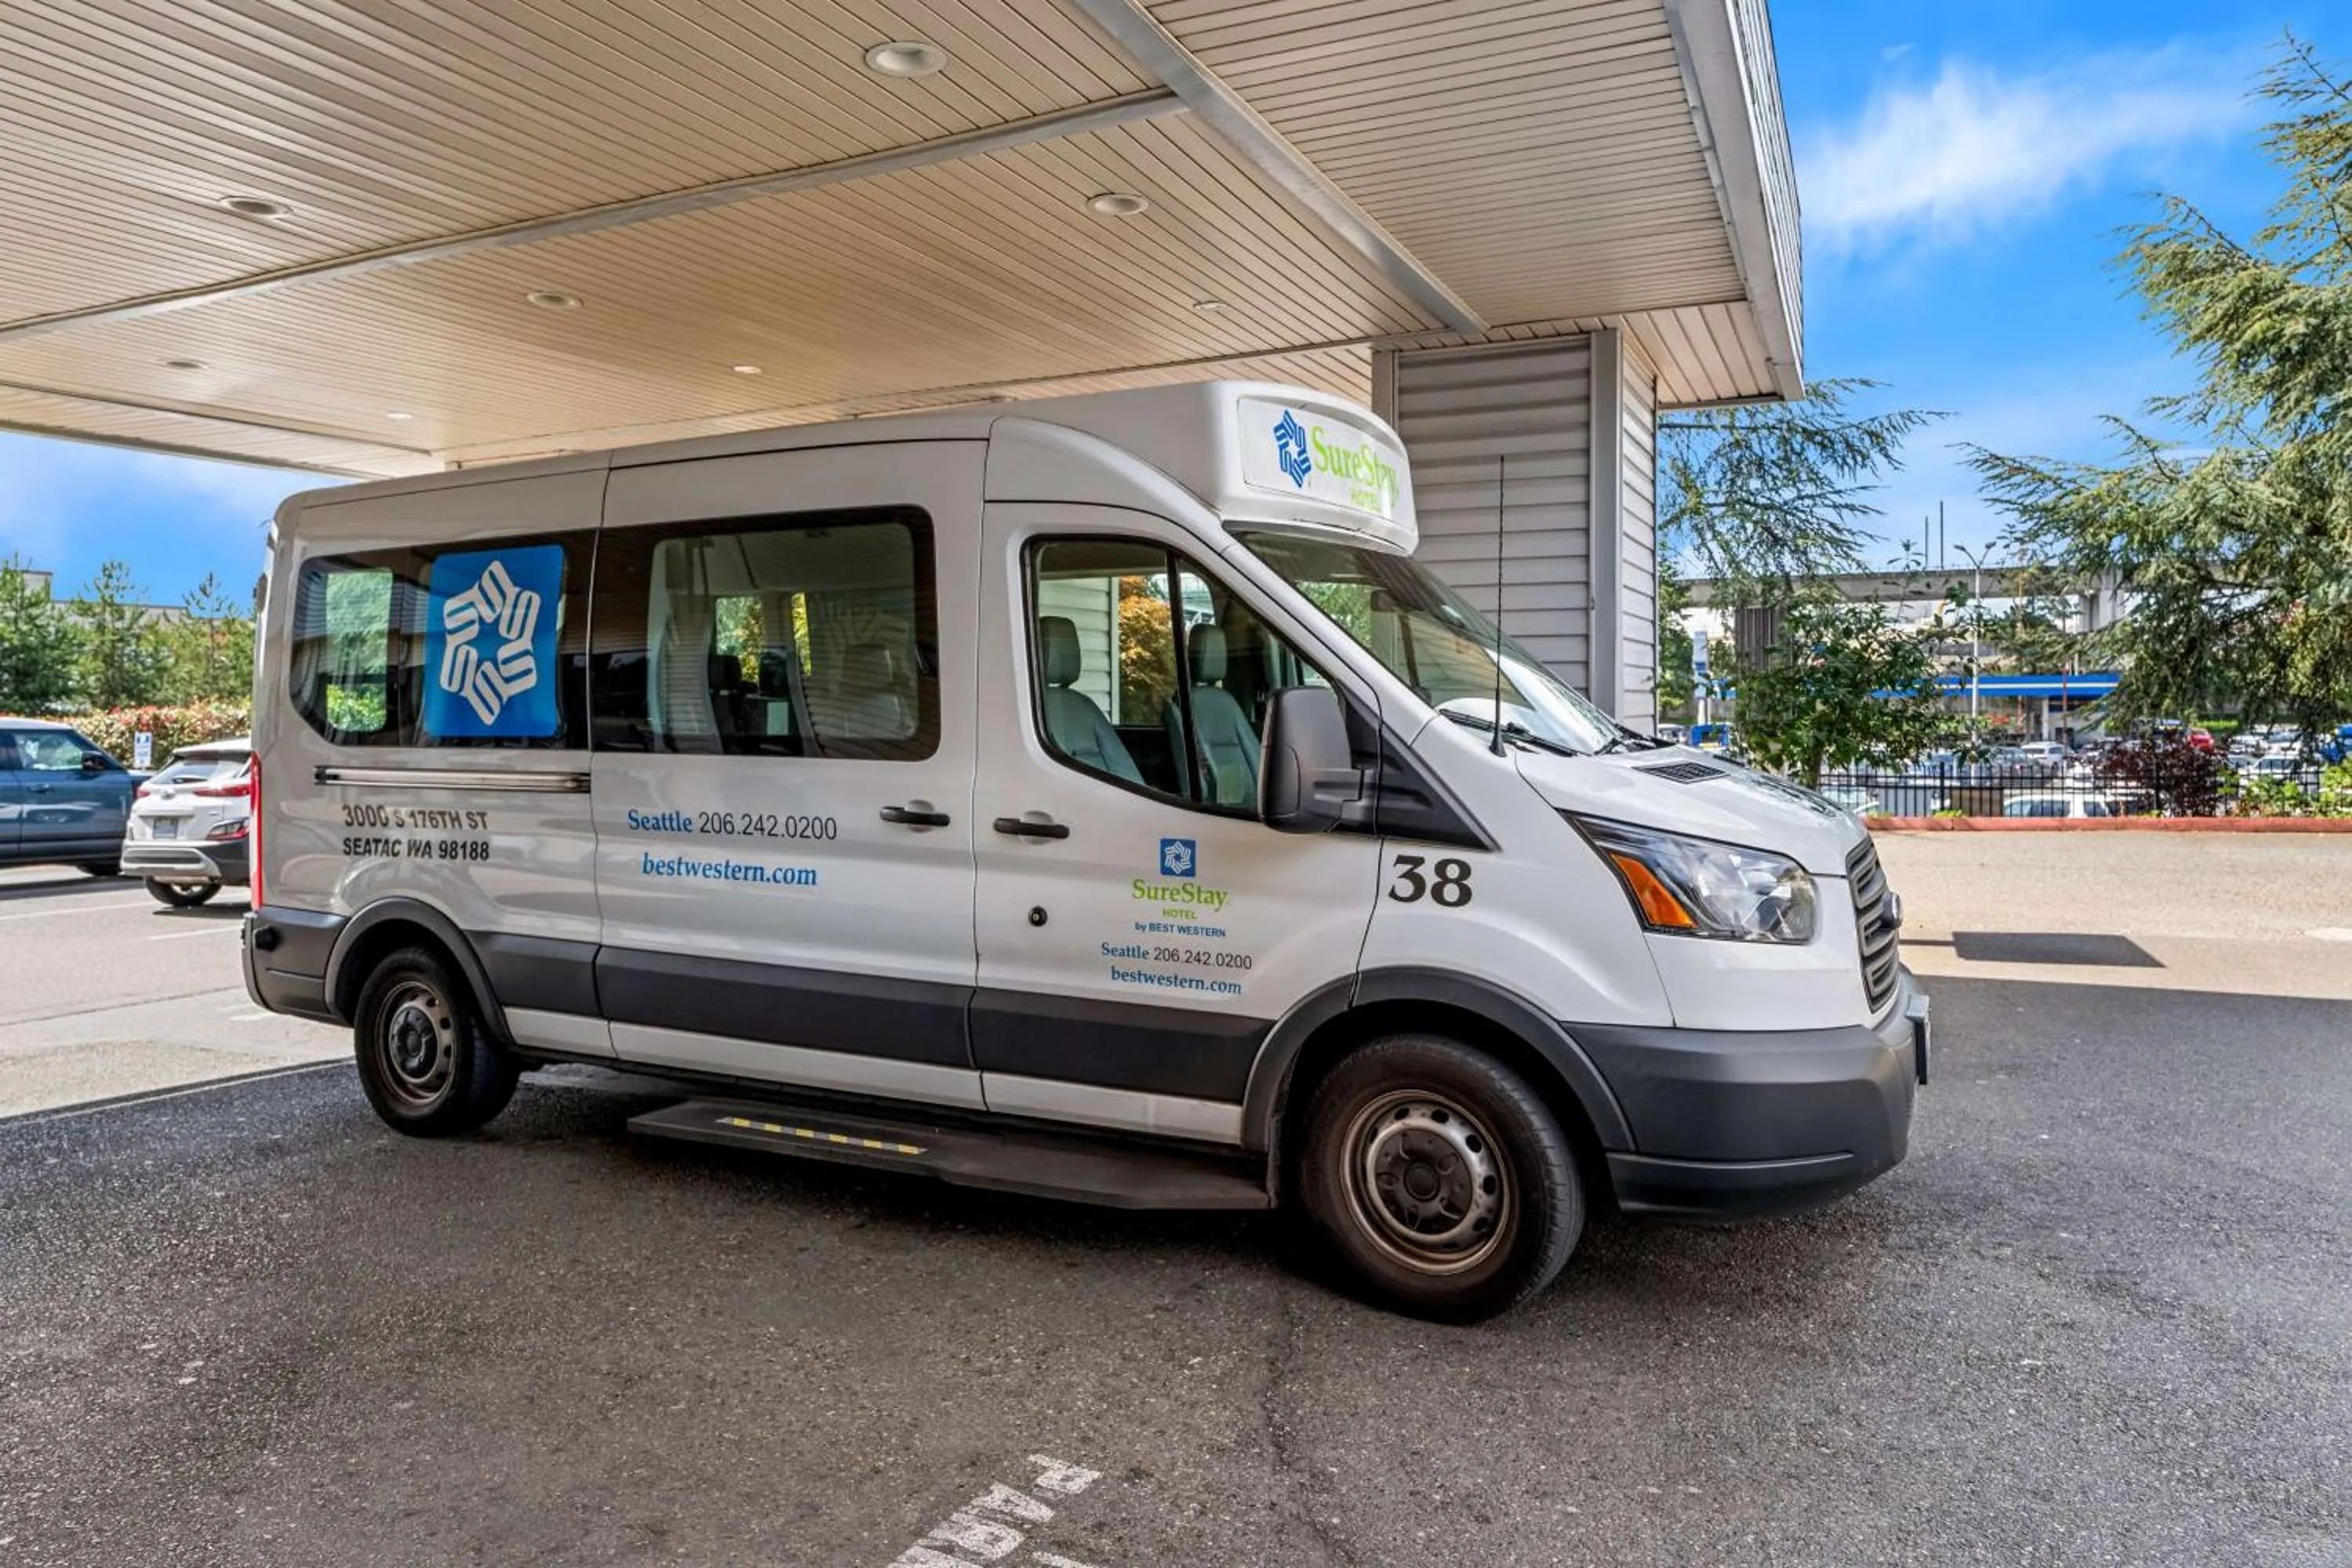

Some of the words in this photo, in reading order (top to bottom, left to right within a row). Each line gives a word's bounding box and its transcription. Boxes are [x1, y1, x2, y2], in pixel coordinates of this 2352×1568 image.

[394, 807, 405, 828] S
[408, 810, 463, 829] 176TH
[466, 811, 488, 830] ST
[627, 809, 693, 833] Seattle
[699, 811, 837, 840] 206.242.0200
[343, 837, 402, 857] SEATAC
[407, 840, 433, 858] WA
[438, 840, 490, 861] 98188
[642, 852, 818, 885] bestwestern.com
[1388, 854, 1473, 907] 38
[1132, 879, 1229, 913] SureStay
[1163, 908, 1198, 920] HOTEL
[1134, 922, 1147, 932] by
[1149, 923, 1175, 933] BEST
[1177, 925, 1226, 938] WESTERN
[1102, 942, 1149, 960] Seattle
[1153, 947, 1252, 970] 206.242.0200
[1111, 966, 1242, 995] bestwestern.com
